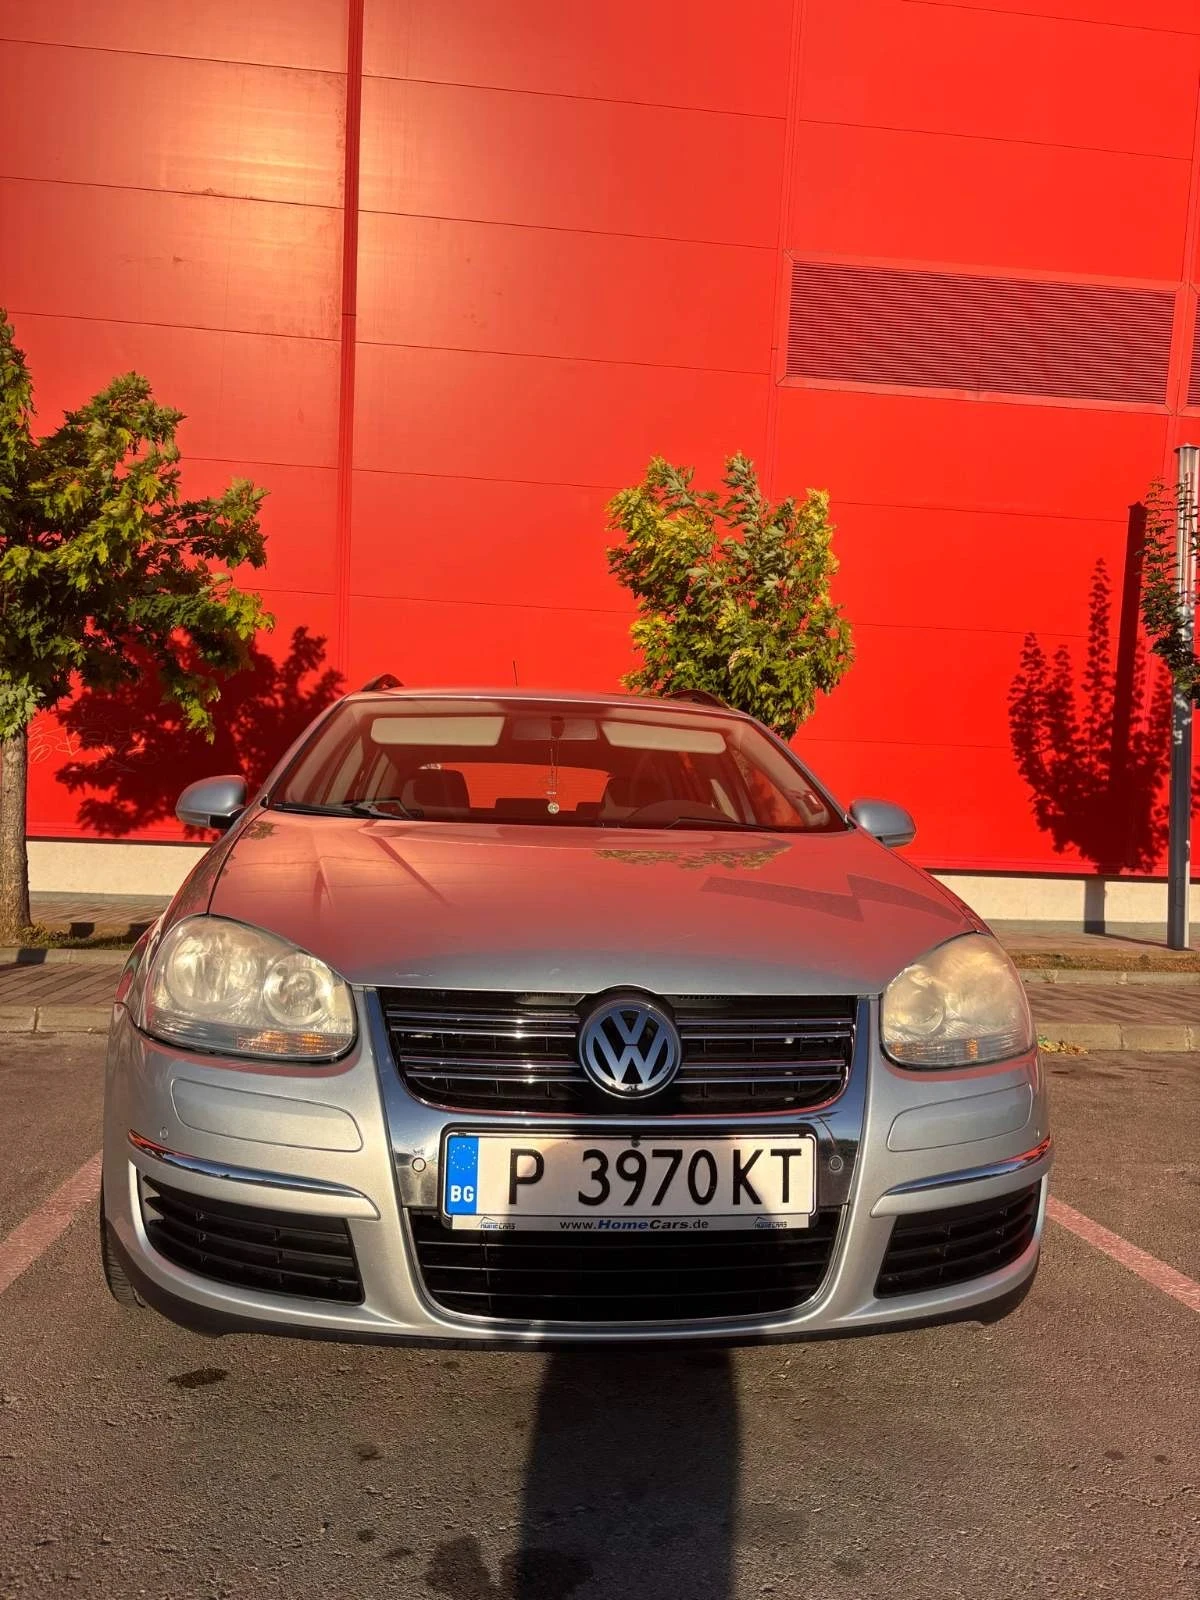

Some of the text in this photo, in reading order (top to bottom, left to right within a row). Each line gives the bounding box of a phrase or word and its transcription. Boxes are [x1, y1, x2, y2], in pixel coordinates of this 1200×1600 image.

[509, 1148, 802, 1206] P 3970 KT
[450, 1185, 474, 1202] BG
[560, 1219, 709, 1230] www.HomeCars.de
